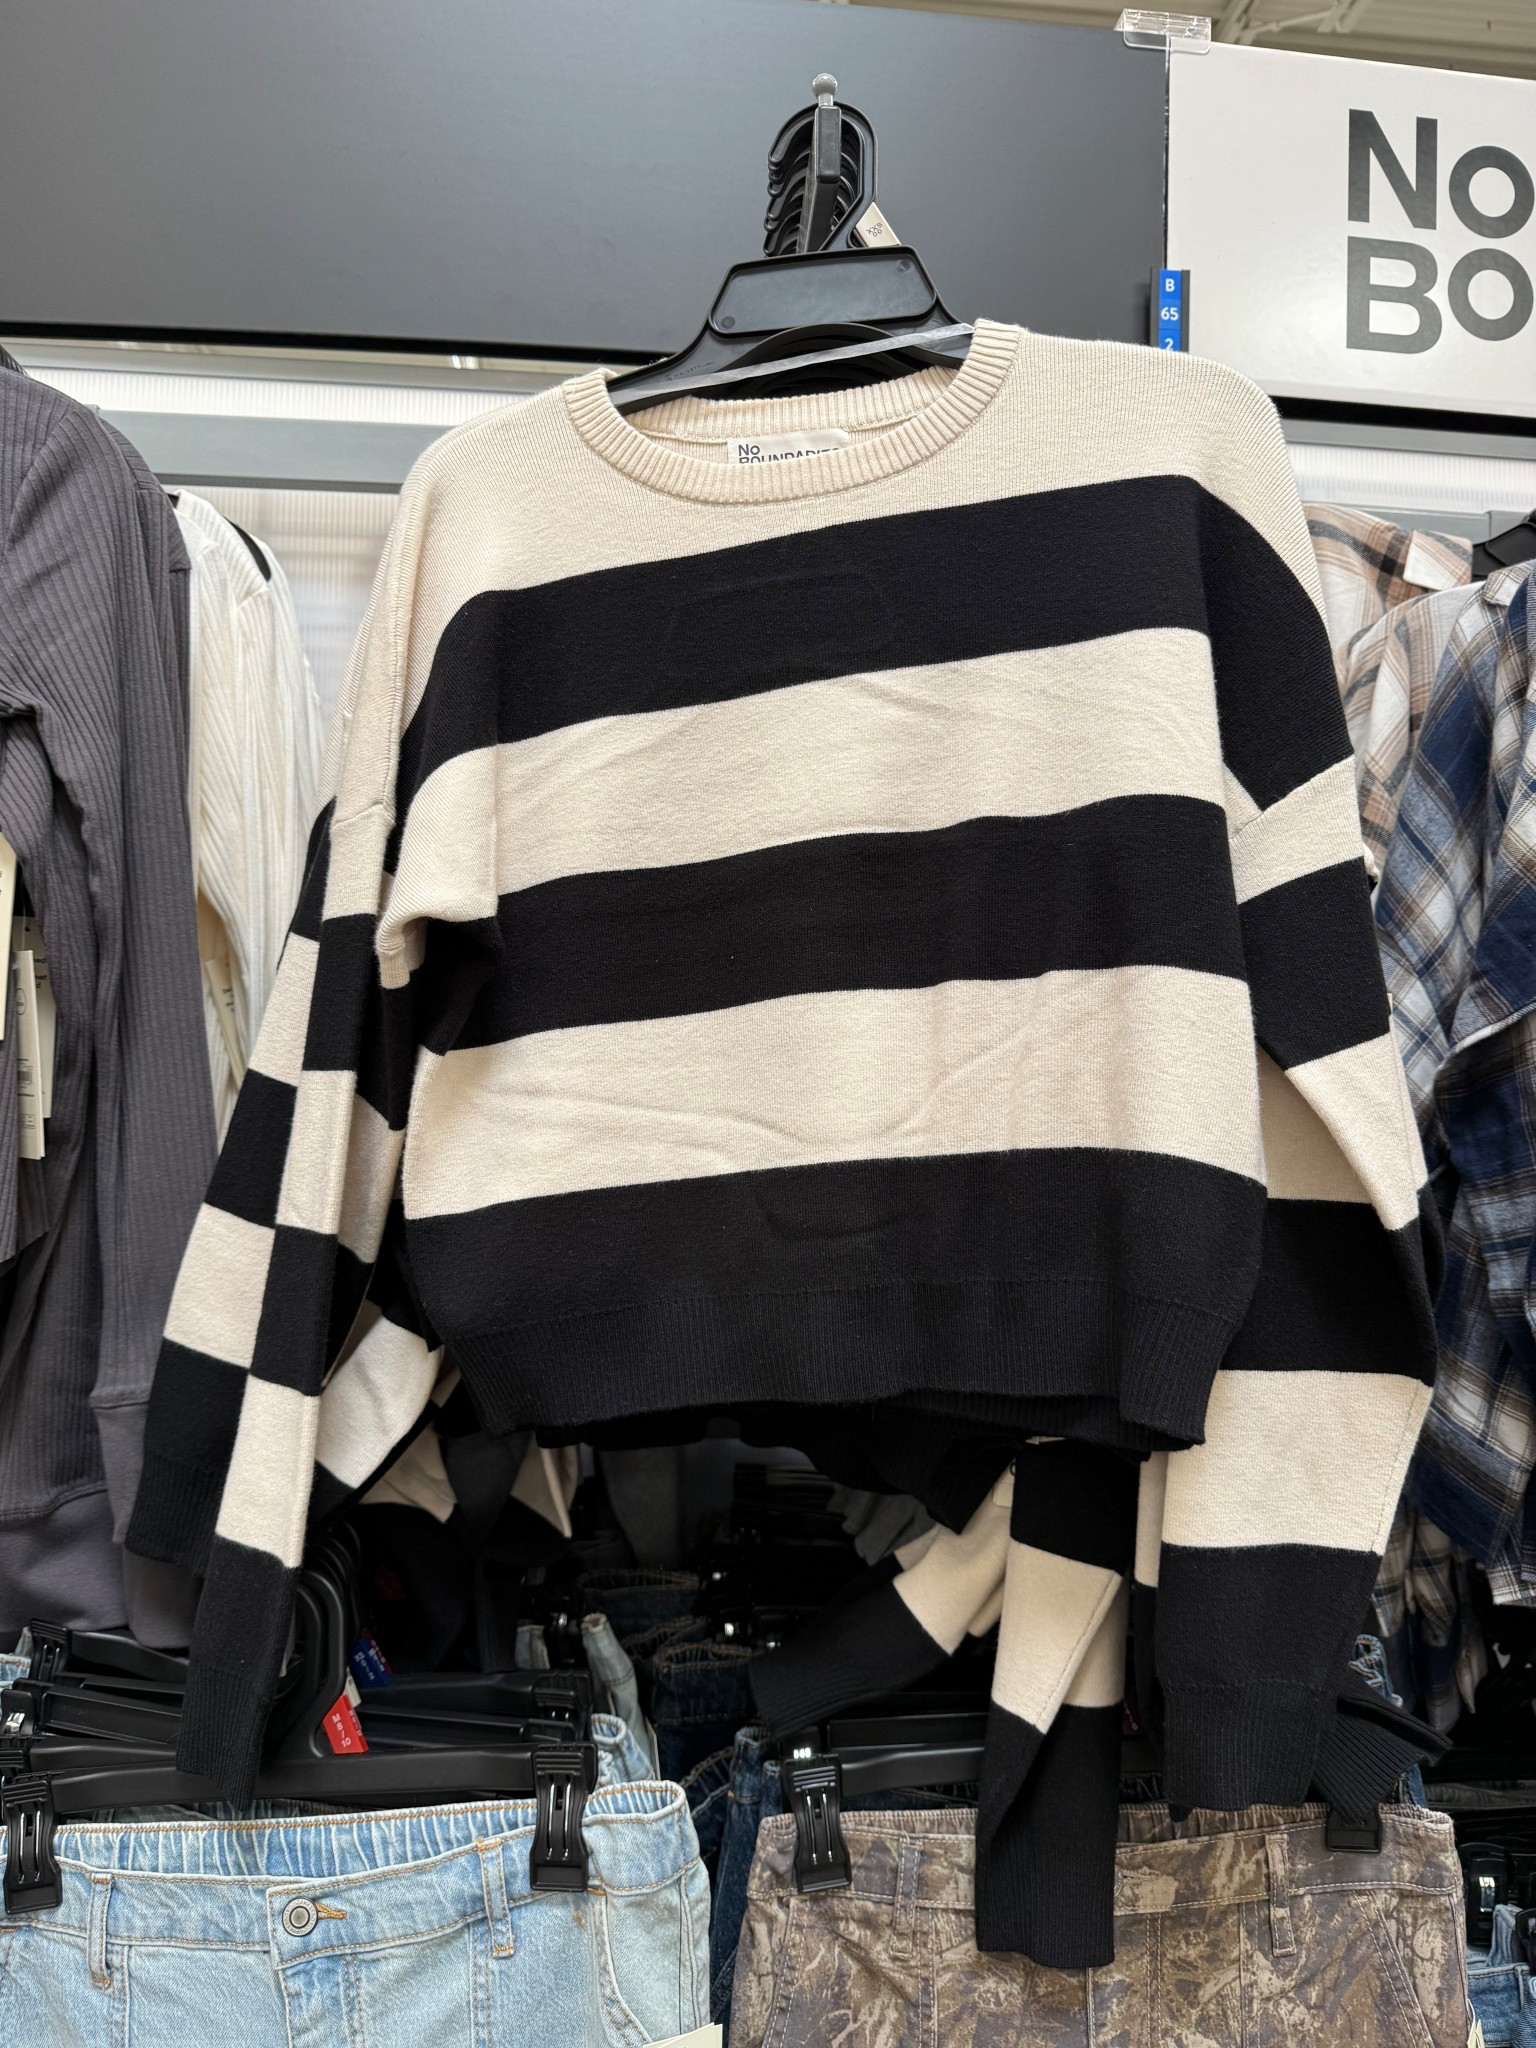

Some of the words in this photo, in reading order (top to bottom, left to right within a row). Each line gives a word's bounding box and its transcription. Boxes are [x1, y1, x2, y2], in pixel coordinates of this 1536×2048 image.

[1347, 108, 1535, 239] No
[1165, 278, 1175, 292] B
[1160, 306, 1179, 321] 65
[1164, 337, 1174, 351] 2
[738, 443, 761, 457] No
